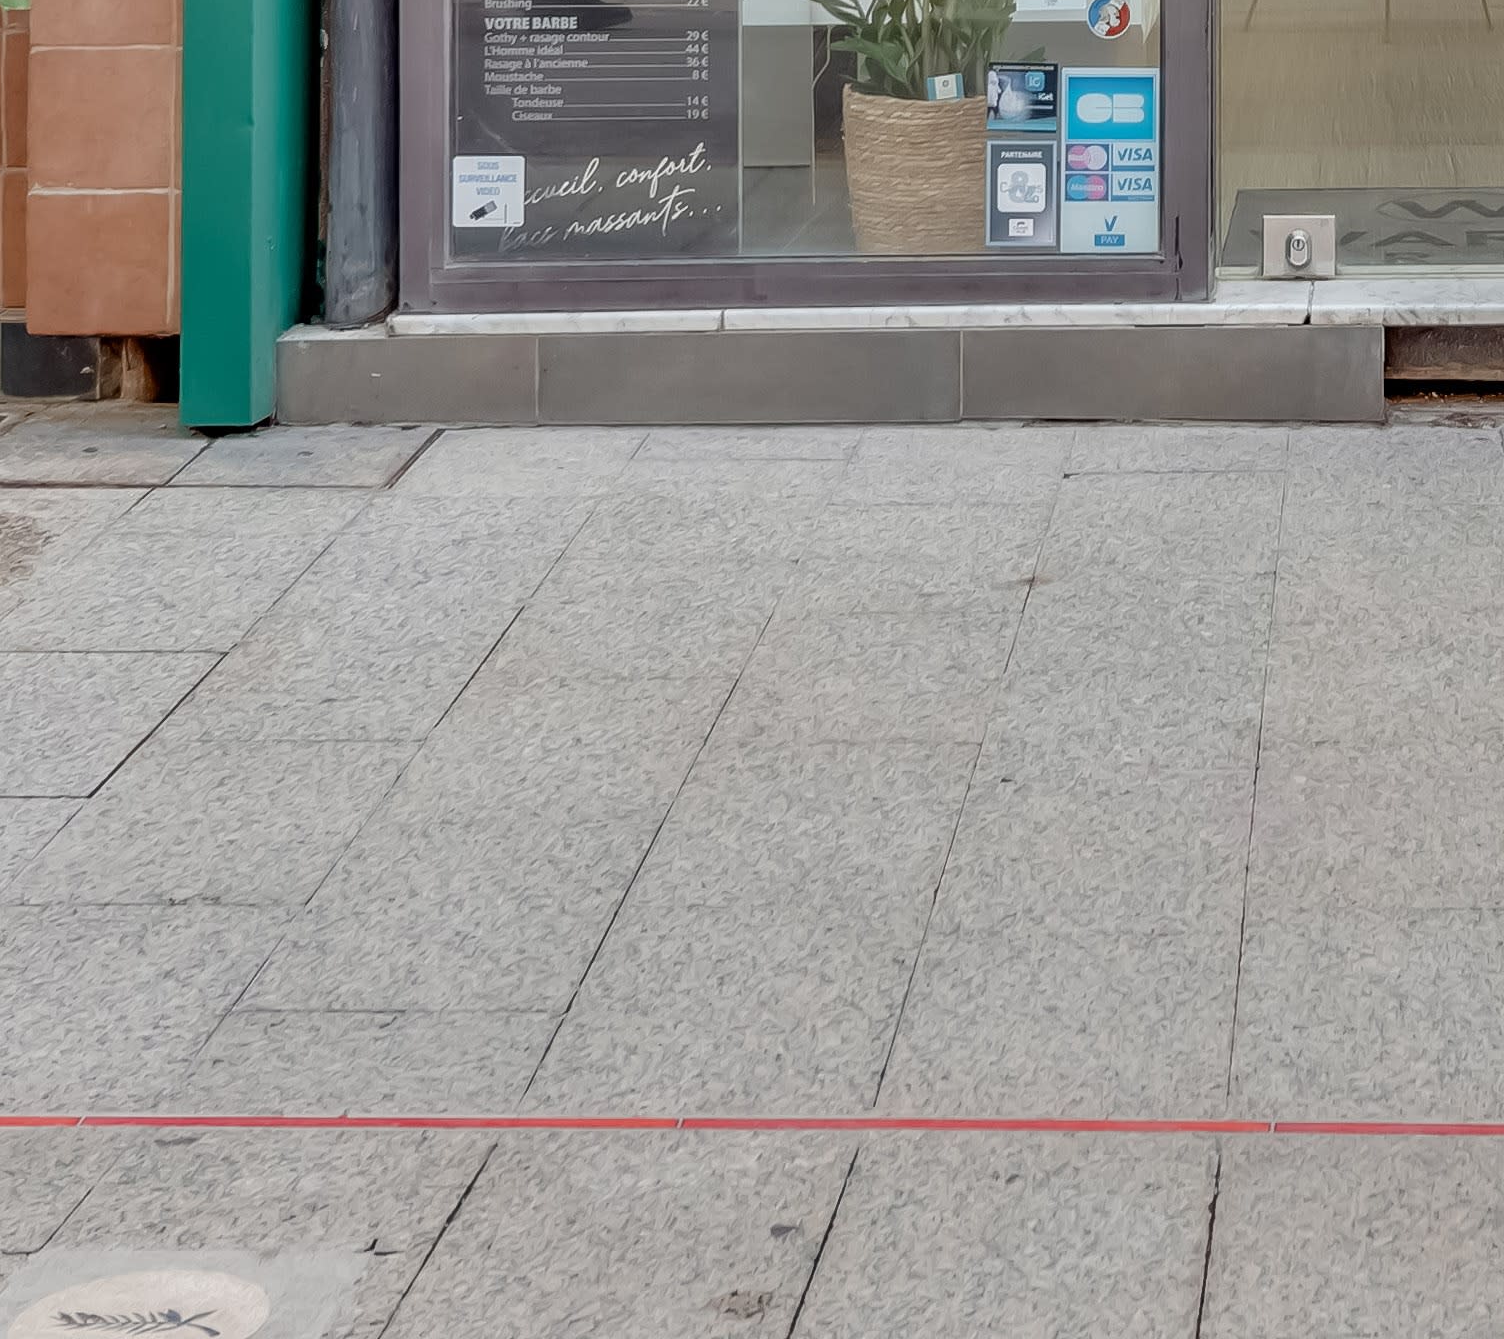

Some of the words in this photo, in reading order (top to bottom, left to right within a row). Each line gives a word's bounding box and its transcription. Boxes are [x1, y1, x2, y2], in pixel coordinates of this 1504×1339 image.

[484, 16, 530, 29] VOTRE
[532, 16, 578, 29] BARBE
[1117, 147, 1153, 161] VISA
[1117, 177, 1153, 191] VISA
